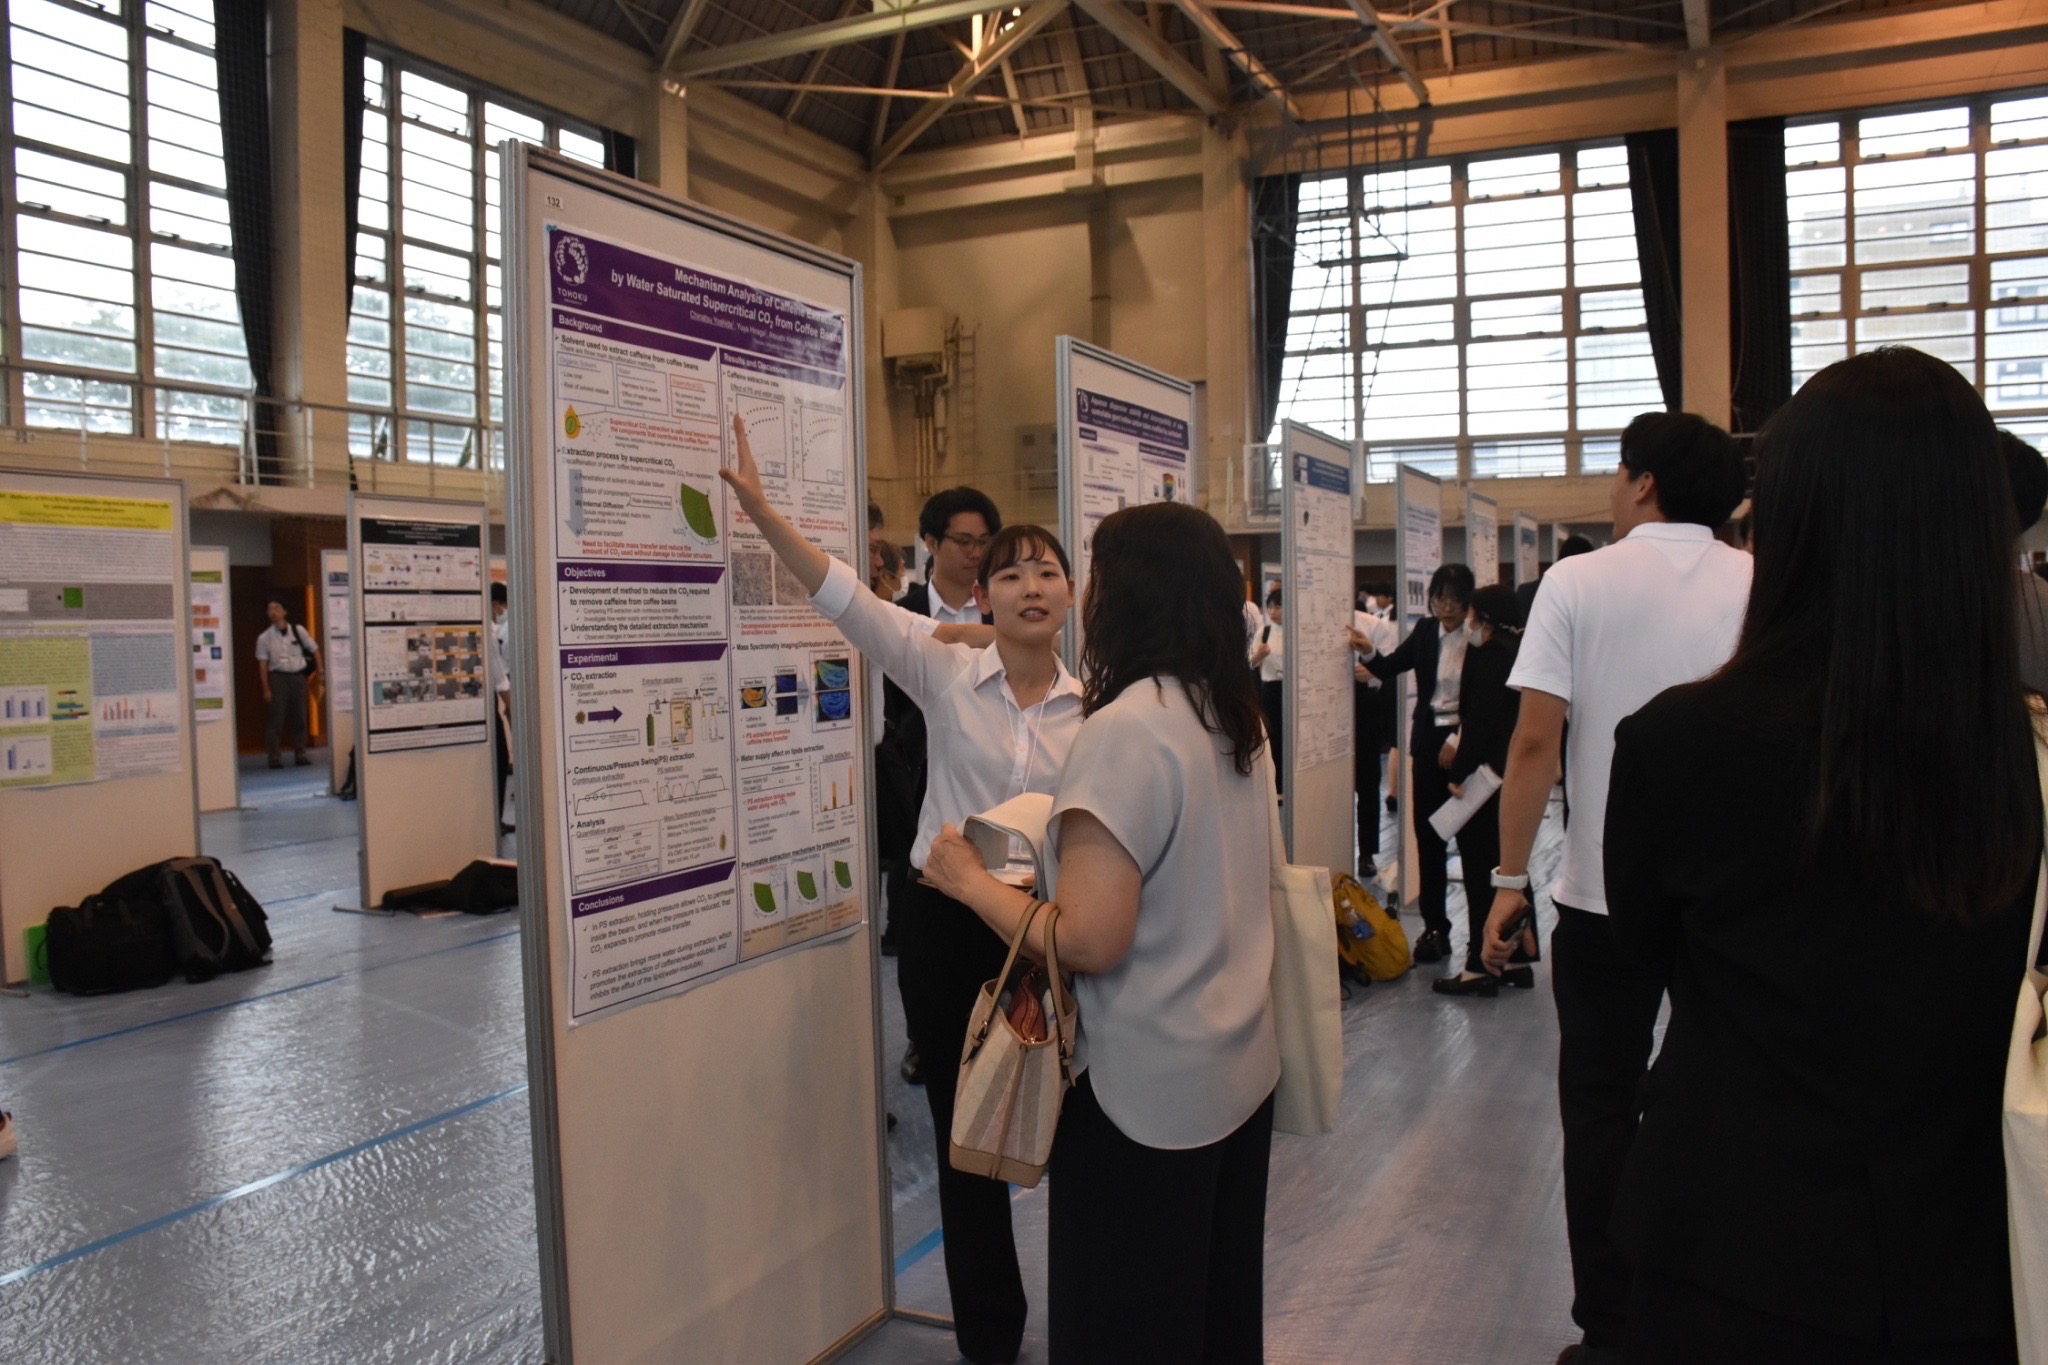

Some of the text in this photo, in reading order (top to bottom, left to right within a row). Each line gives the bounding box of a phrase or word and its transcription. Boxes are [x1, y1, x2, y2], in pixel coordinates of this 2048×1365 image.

[547, 196, 560, 208] 132
[557, 287, 587, 302] TOHOKU
[674, 269, 725, 294] Mechanism
[727, 284, 762, 304] Analysis
[765, 296, 772, 307] of
[774, 298, 804, 316] Caffeine
[611, 270, 623, 288] by
[626, 274, 654, 293] Water
[656, 282, 700, 305] Saturated
[702, 295, 755, 319] Supercritical
[775, 314, 792, 329] from
[794, 320, 817, 336] Coffee
[820, 326, 841, 342] Beans
[558, 314, 602, 332] Background
[561, 335, 698, 370] Solvent used to extract caffeine from coffee beans
[561, 446, 594, 457] Extraction
[596, 452, 619, 460] process
[620, 453, 628, 463] by
[629, 456, 662, 465] supercritical
[565, 568, 605, 578] Objectives
[569, 586, 611, 596] Development
[689, 587, 709, 596] required
[570, 623, 617, 632] Understanding
[567, 652, 618, 664] Experimental
[585, 671, 616, 680] extraction
[573, 752, 694, 775] Continuous/Pressure Swing(PS) extraction
[576, 817, 605, 829] Analysis
[578, 894, 623, 912] Conclusions
[599, 920, 607, 929] PS
[608, 914, 635, 926] extraction,
[637, 909, 656, 918] holding
[657, 903, 679, 915] pressure
[680, 898, 695, 907] allows
[713, 887, 734, 899] permeate
[590, 933, 606, 943] inside
[608, 930, 617, 938] the
[618, 926, 635, 935] beans,
[637, 920, 647, 930] and
[648, 918, 662, 926] when
[673, 909, 694, 921] pressure
[700, 901, 720, 912] reduced,
[721, 898, 730, 906] that
[604, 938, 626, 950] expands
[634, 929, 655, 942] promote
[657, 926, 670, 934] mass
[672, 920, 690, 930] transfer
[592, 930, 732, 979] PS extraction brings more water during extraction, which
[589, 977, 616, 992] promotes
[627, 966, 653, 978] extraction
[717, 941, 726, 950] and
[590, 989, 610, 1001] inhibits
[621, 982, 635, 991] efflux
